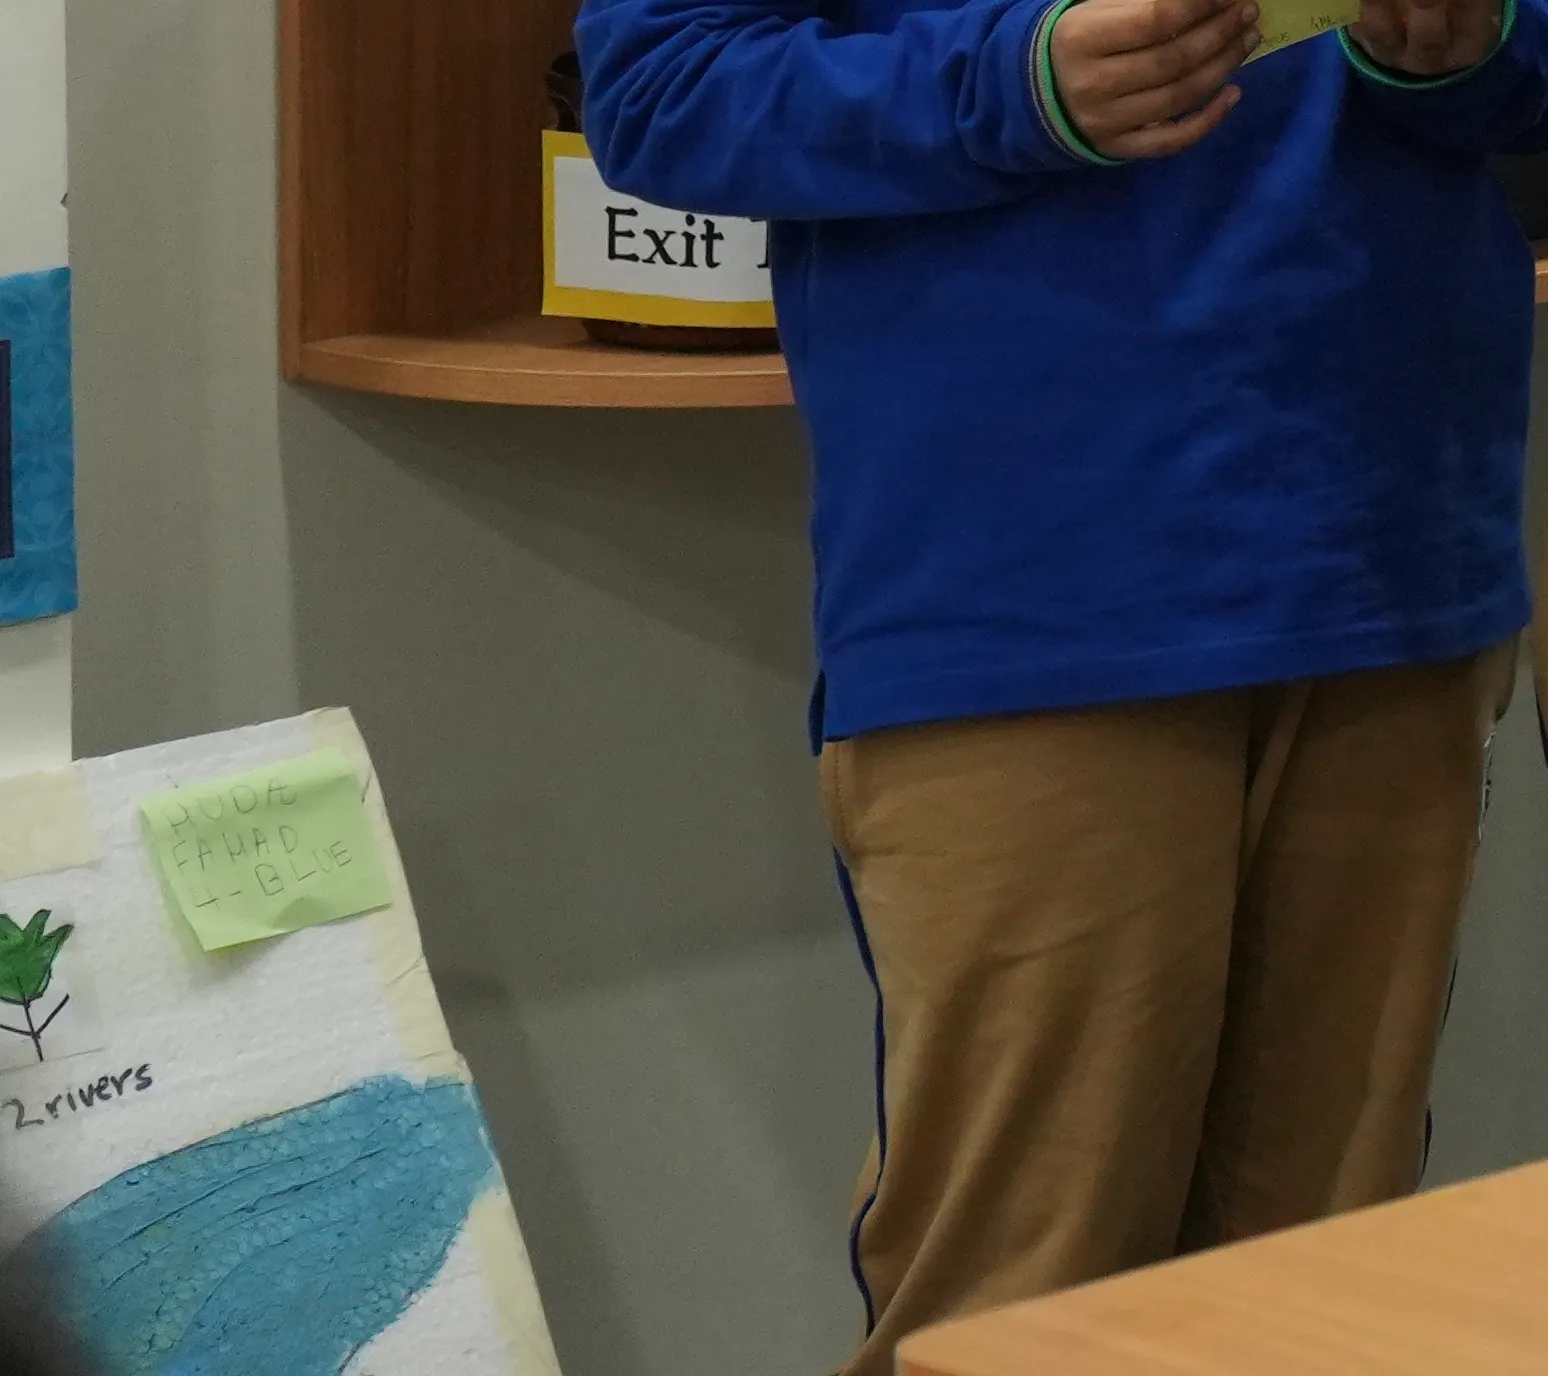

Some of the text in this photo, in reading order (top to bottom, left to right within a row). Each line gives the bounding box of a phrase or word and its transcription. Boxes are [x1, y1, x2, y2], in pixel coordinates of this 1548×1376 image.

[604, 205, 725, 269] Exit
[0, 1063, 153, 1130] 2 rivers
